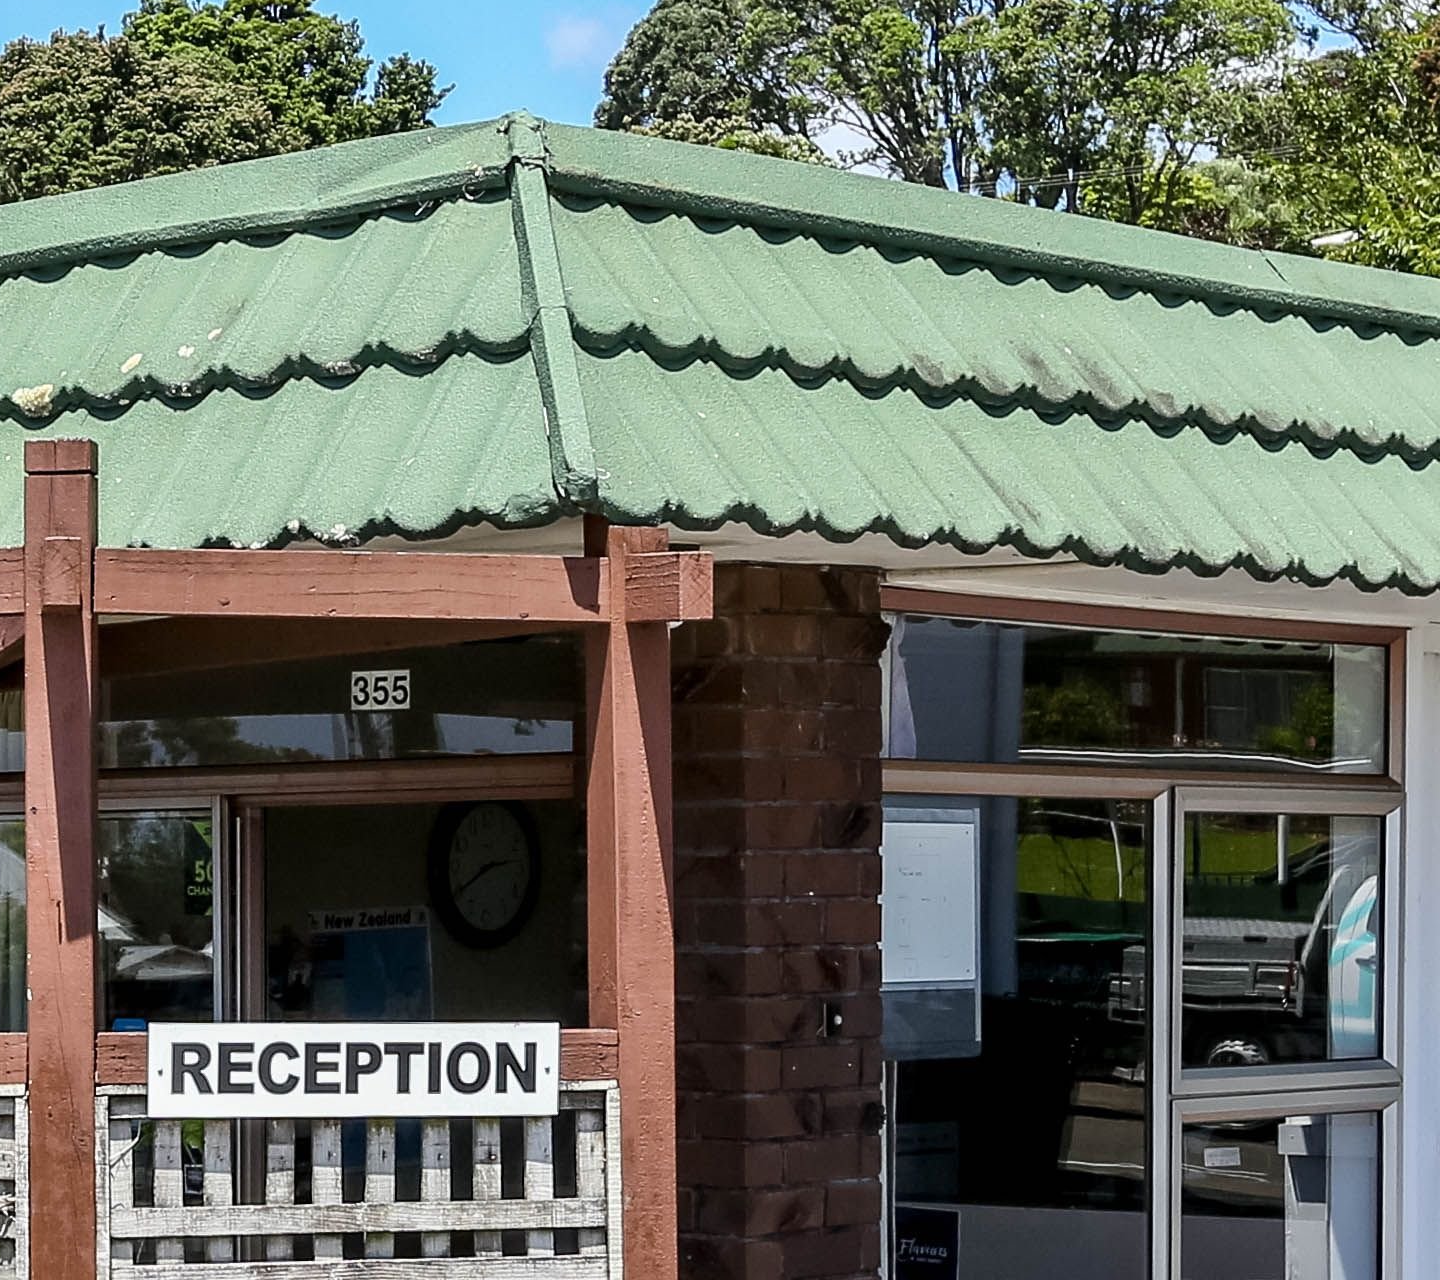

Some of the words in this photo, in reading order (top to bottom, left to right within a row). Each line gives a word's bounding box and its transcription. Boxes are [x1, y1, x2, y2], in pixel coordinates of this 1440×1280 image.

[352, 675, 409, 706] 355
[325, 914, 354, 929] New
[359, 910, 411, 927] Zealand
[170, 1042, 537, 1095] RECEPTION
